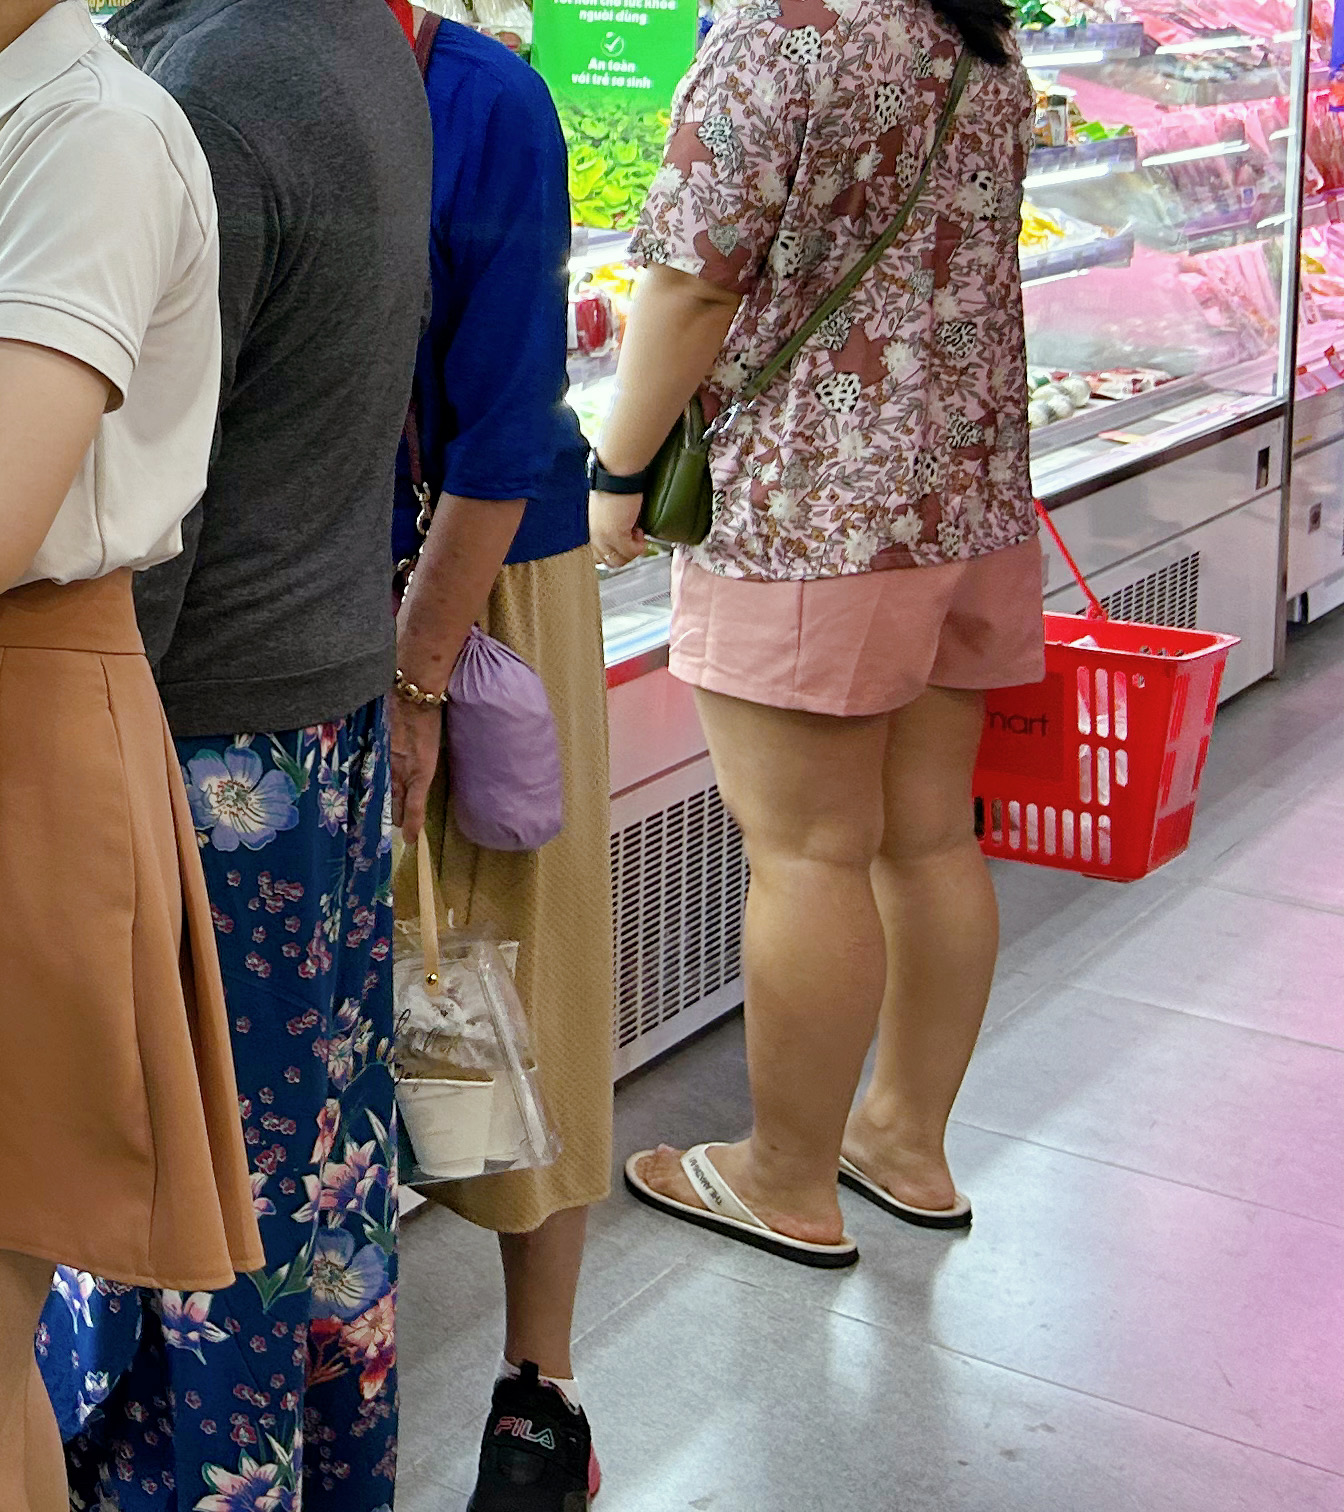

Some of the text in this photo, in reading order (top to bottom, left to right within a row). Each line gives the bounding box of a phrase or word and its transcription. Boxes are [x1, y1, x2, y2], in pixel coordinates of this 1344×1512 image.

[615, 8, 649, 27] dùng
[587, 57, 636, 74] An toàn
[626, 74, 652, 89] sinh
[985, 710, 1050, 738] mart
[493, 1415, 556, 1450] FILA
